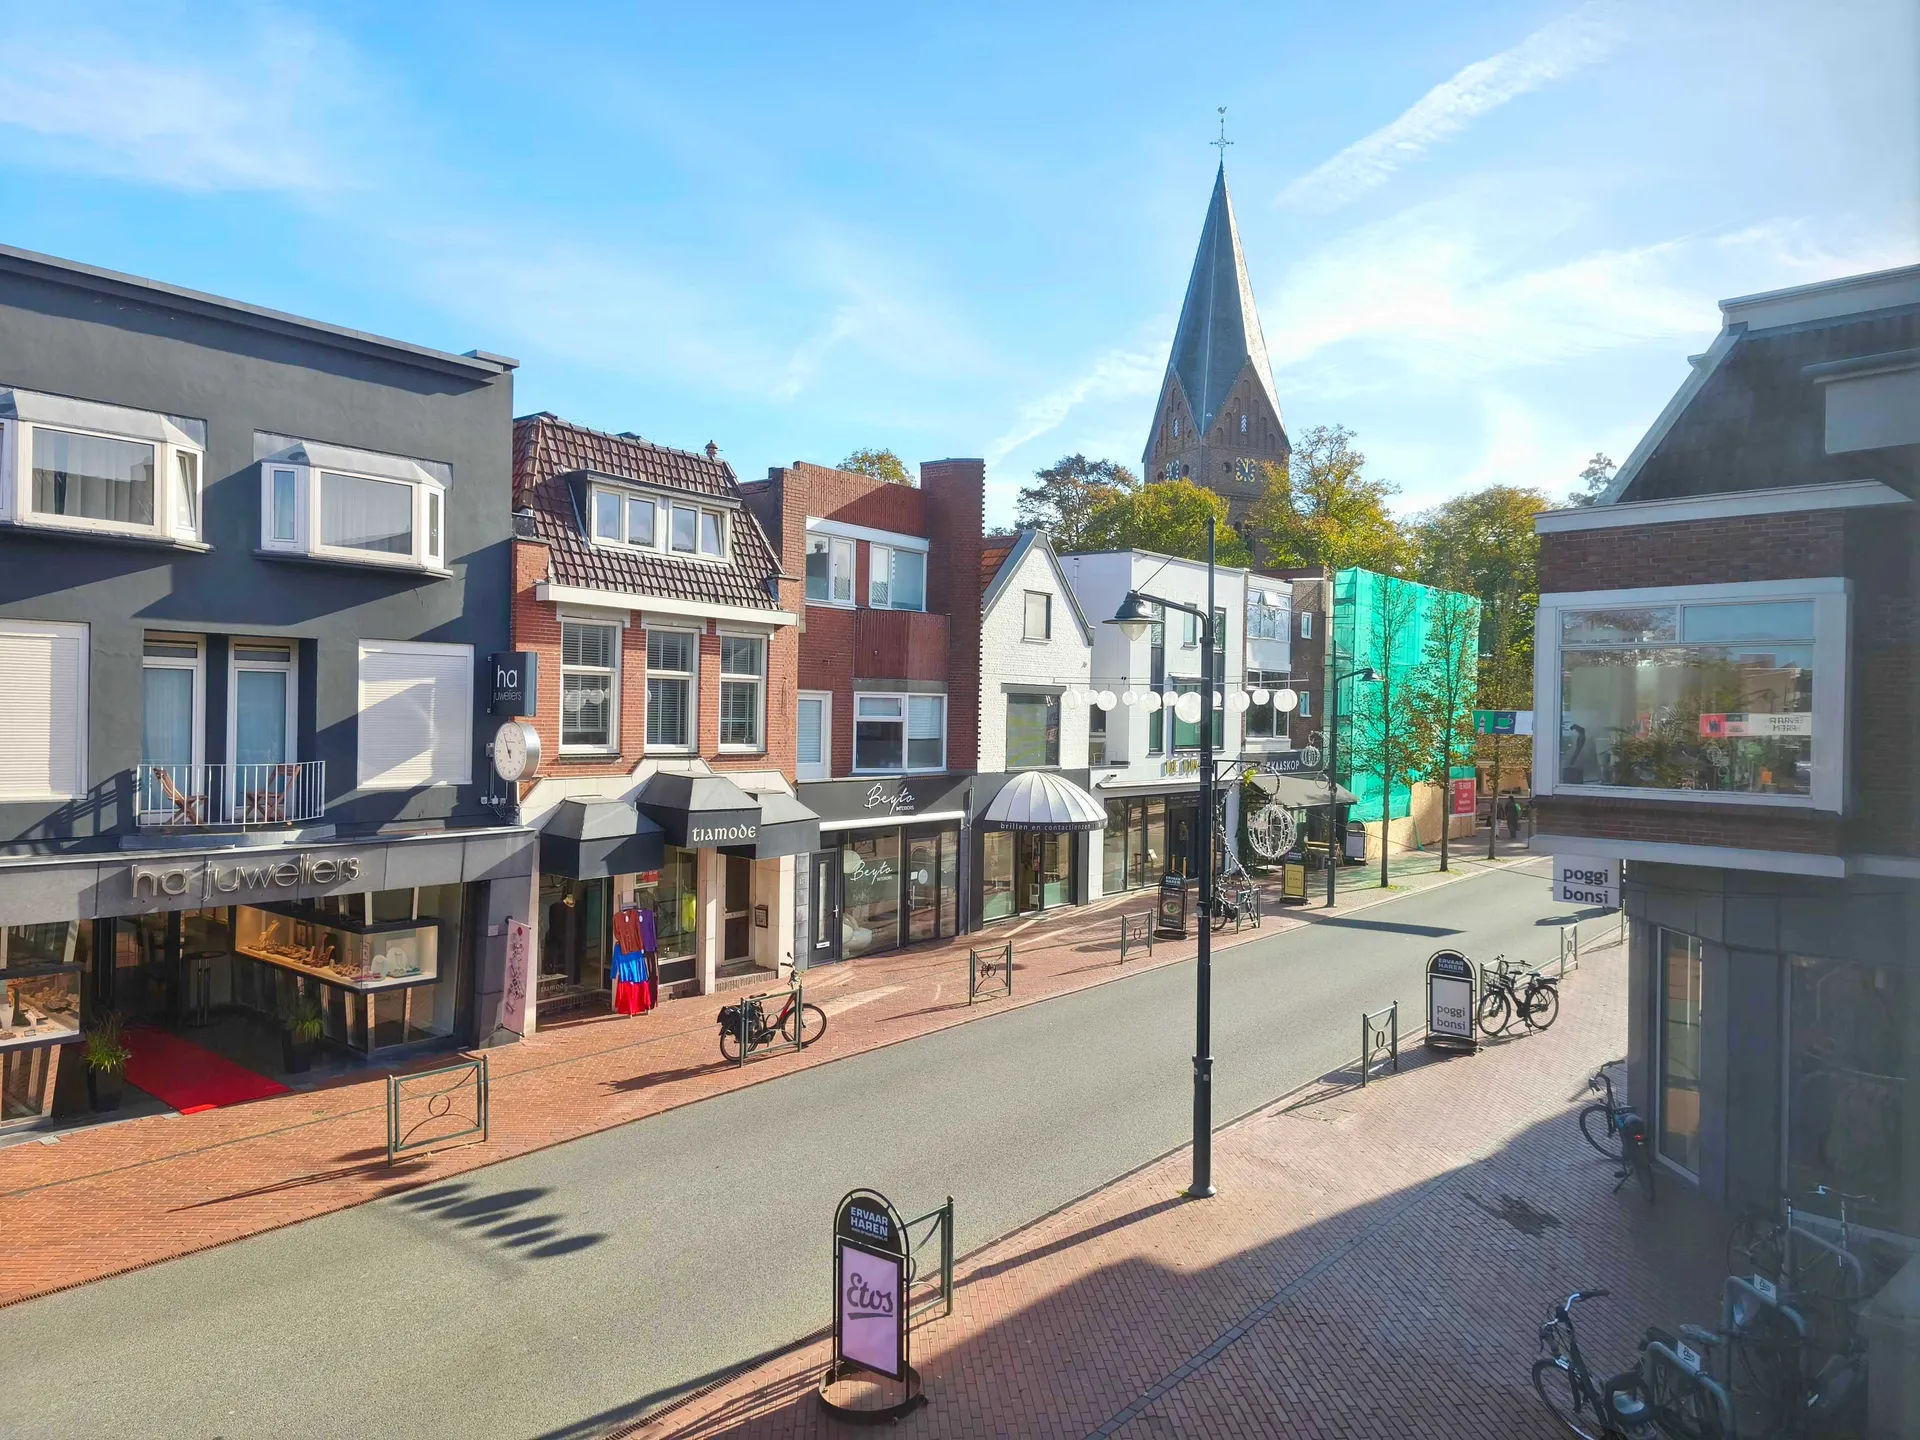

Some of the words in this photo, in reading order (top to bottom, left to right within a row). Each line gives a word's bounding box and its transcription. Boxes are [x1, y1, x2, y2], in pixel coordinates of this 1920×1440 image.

[497, 664, 518, 688] ha
[492, 689, 522, 703] juweliers
[1271, 760, 1300, 771] KAASKOP
[864, 782, 915, 815] Beyto
[692, 823, 757, 842] tiamode
[1000, 822, 1028, 830] brillen
[132, 864, 191, 898] ha
[203, 853, 361, 902] juweliers
[850, 859, 893, 885] Beyto
[1563, 868, 1608, 886] poggi
[1563, 885, 1608, 904] bonsi
[1438, 957, 1464, 966] ERVAAR
[1438, 963, 1464, 972] HAREN
[1436, 1005, 1466, 1019] poggi
[1436, 1017, 1466, 1031] bonsi
[850, 1206, 889, 1226] ERVAAR
[850, 1215, 889, 1237] HAREN
[846, 1272, 894, 1314] Etos
